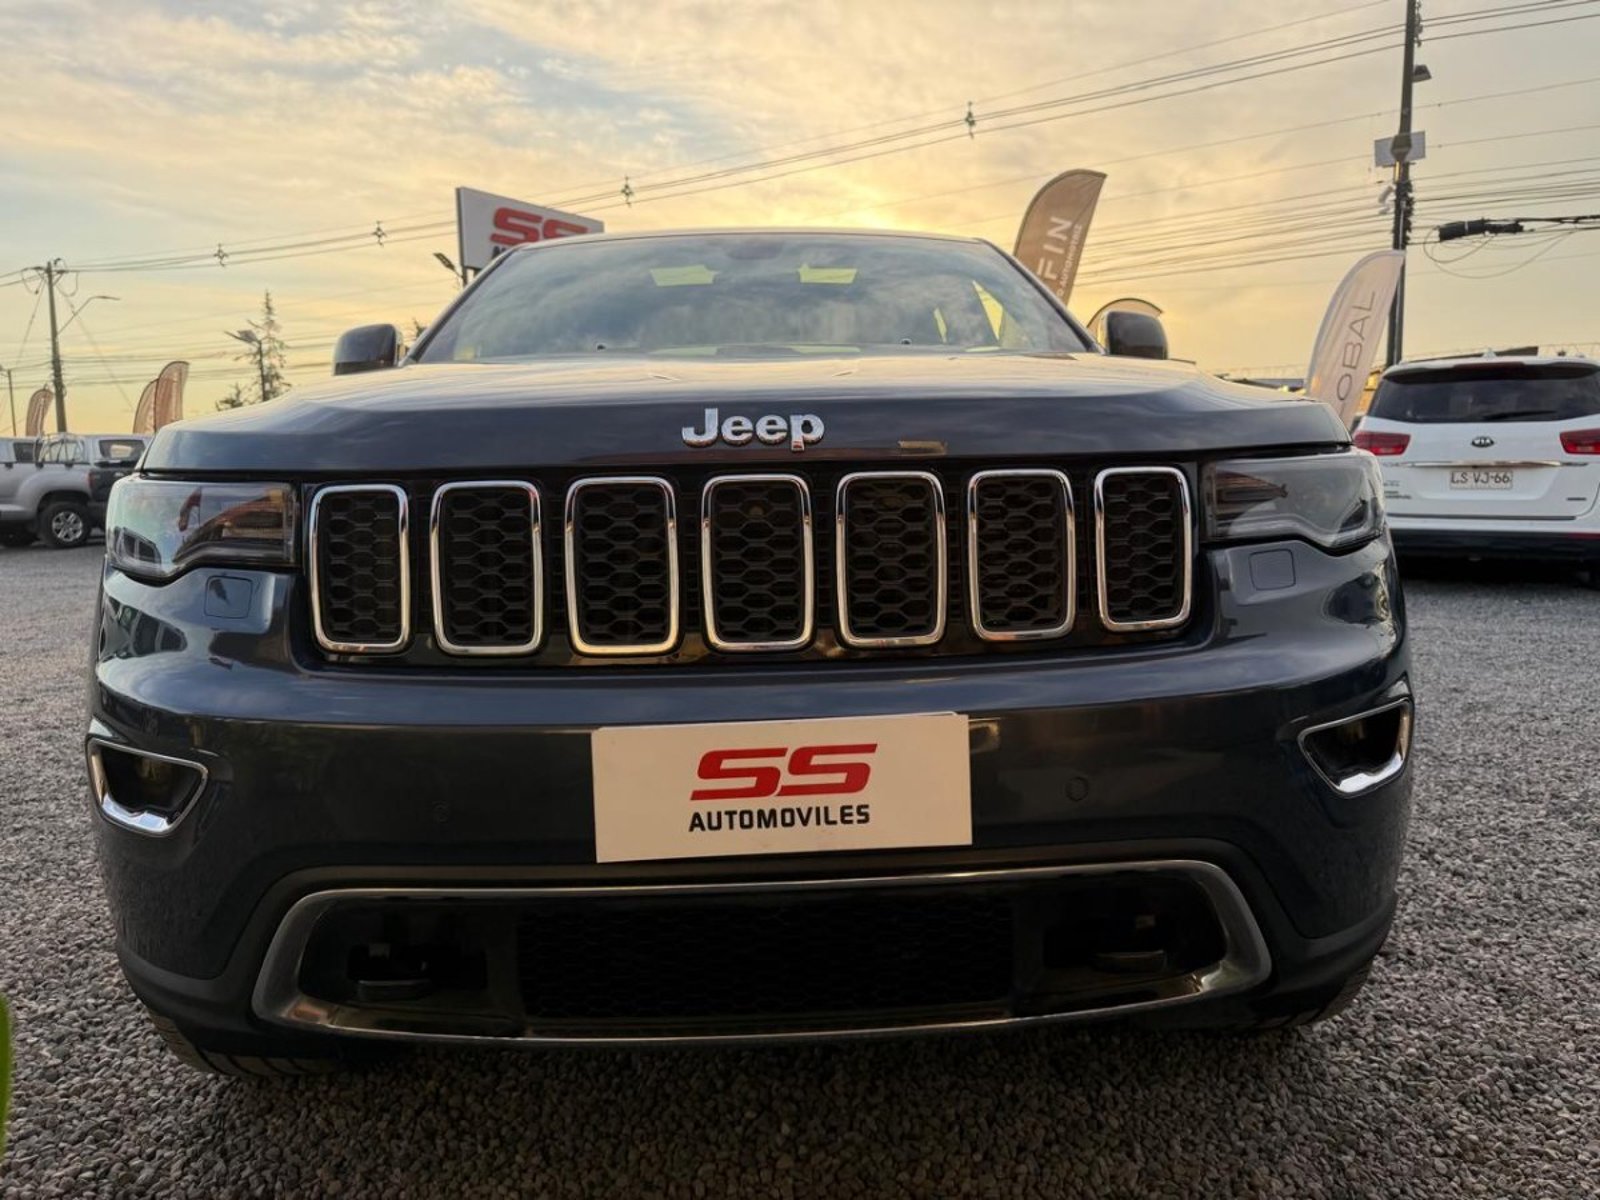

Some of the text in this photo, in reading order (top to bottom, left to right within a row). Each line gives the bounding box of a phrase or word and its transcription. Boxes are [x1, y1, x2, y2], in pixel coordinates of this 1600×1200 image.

[681, 408, 825, 451] Jeep
[690, 743, 878, 801] SS
[688, 804, 870, 832] AUTOMOVILES
